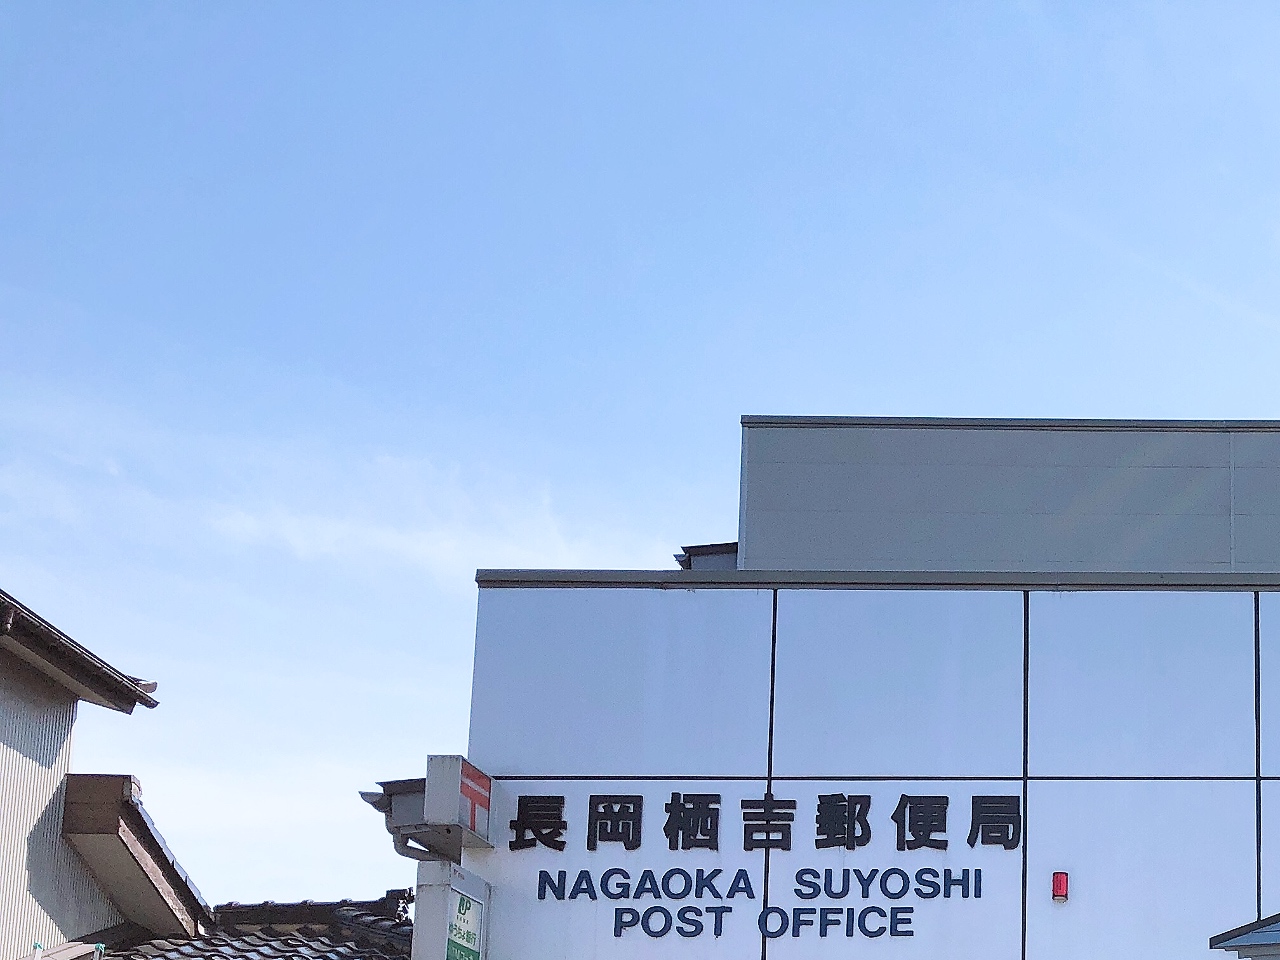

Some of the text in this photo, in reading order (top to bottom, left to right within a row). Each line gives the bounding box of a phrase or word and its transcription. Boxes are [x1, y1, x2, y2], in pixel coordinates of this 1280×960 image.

[509, 792, 1021, 851] 長岡栖吉郵便局
[537, 868, 982, 900] NAGAOKA SUYOSHI
[613, 906, 914, 938] POST OFFICE
